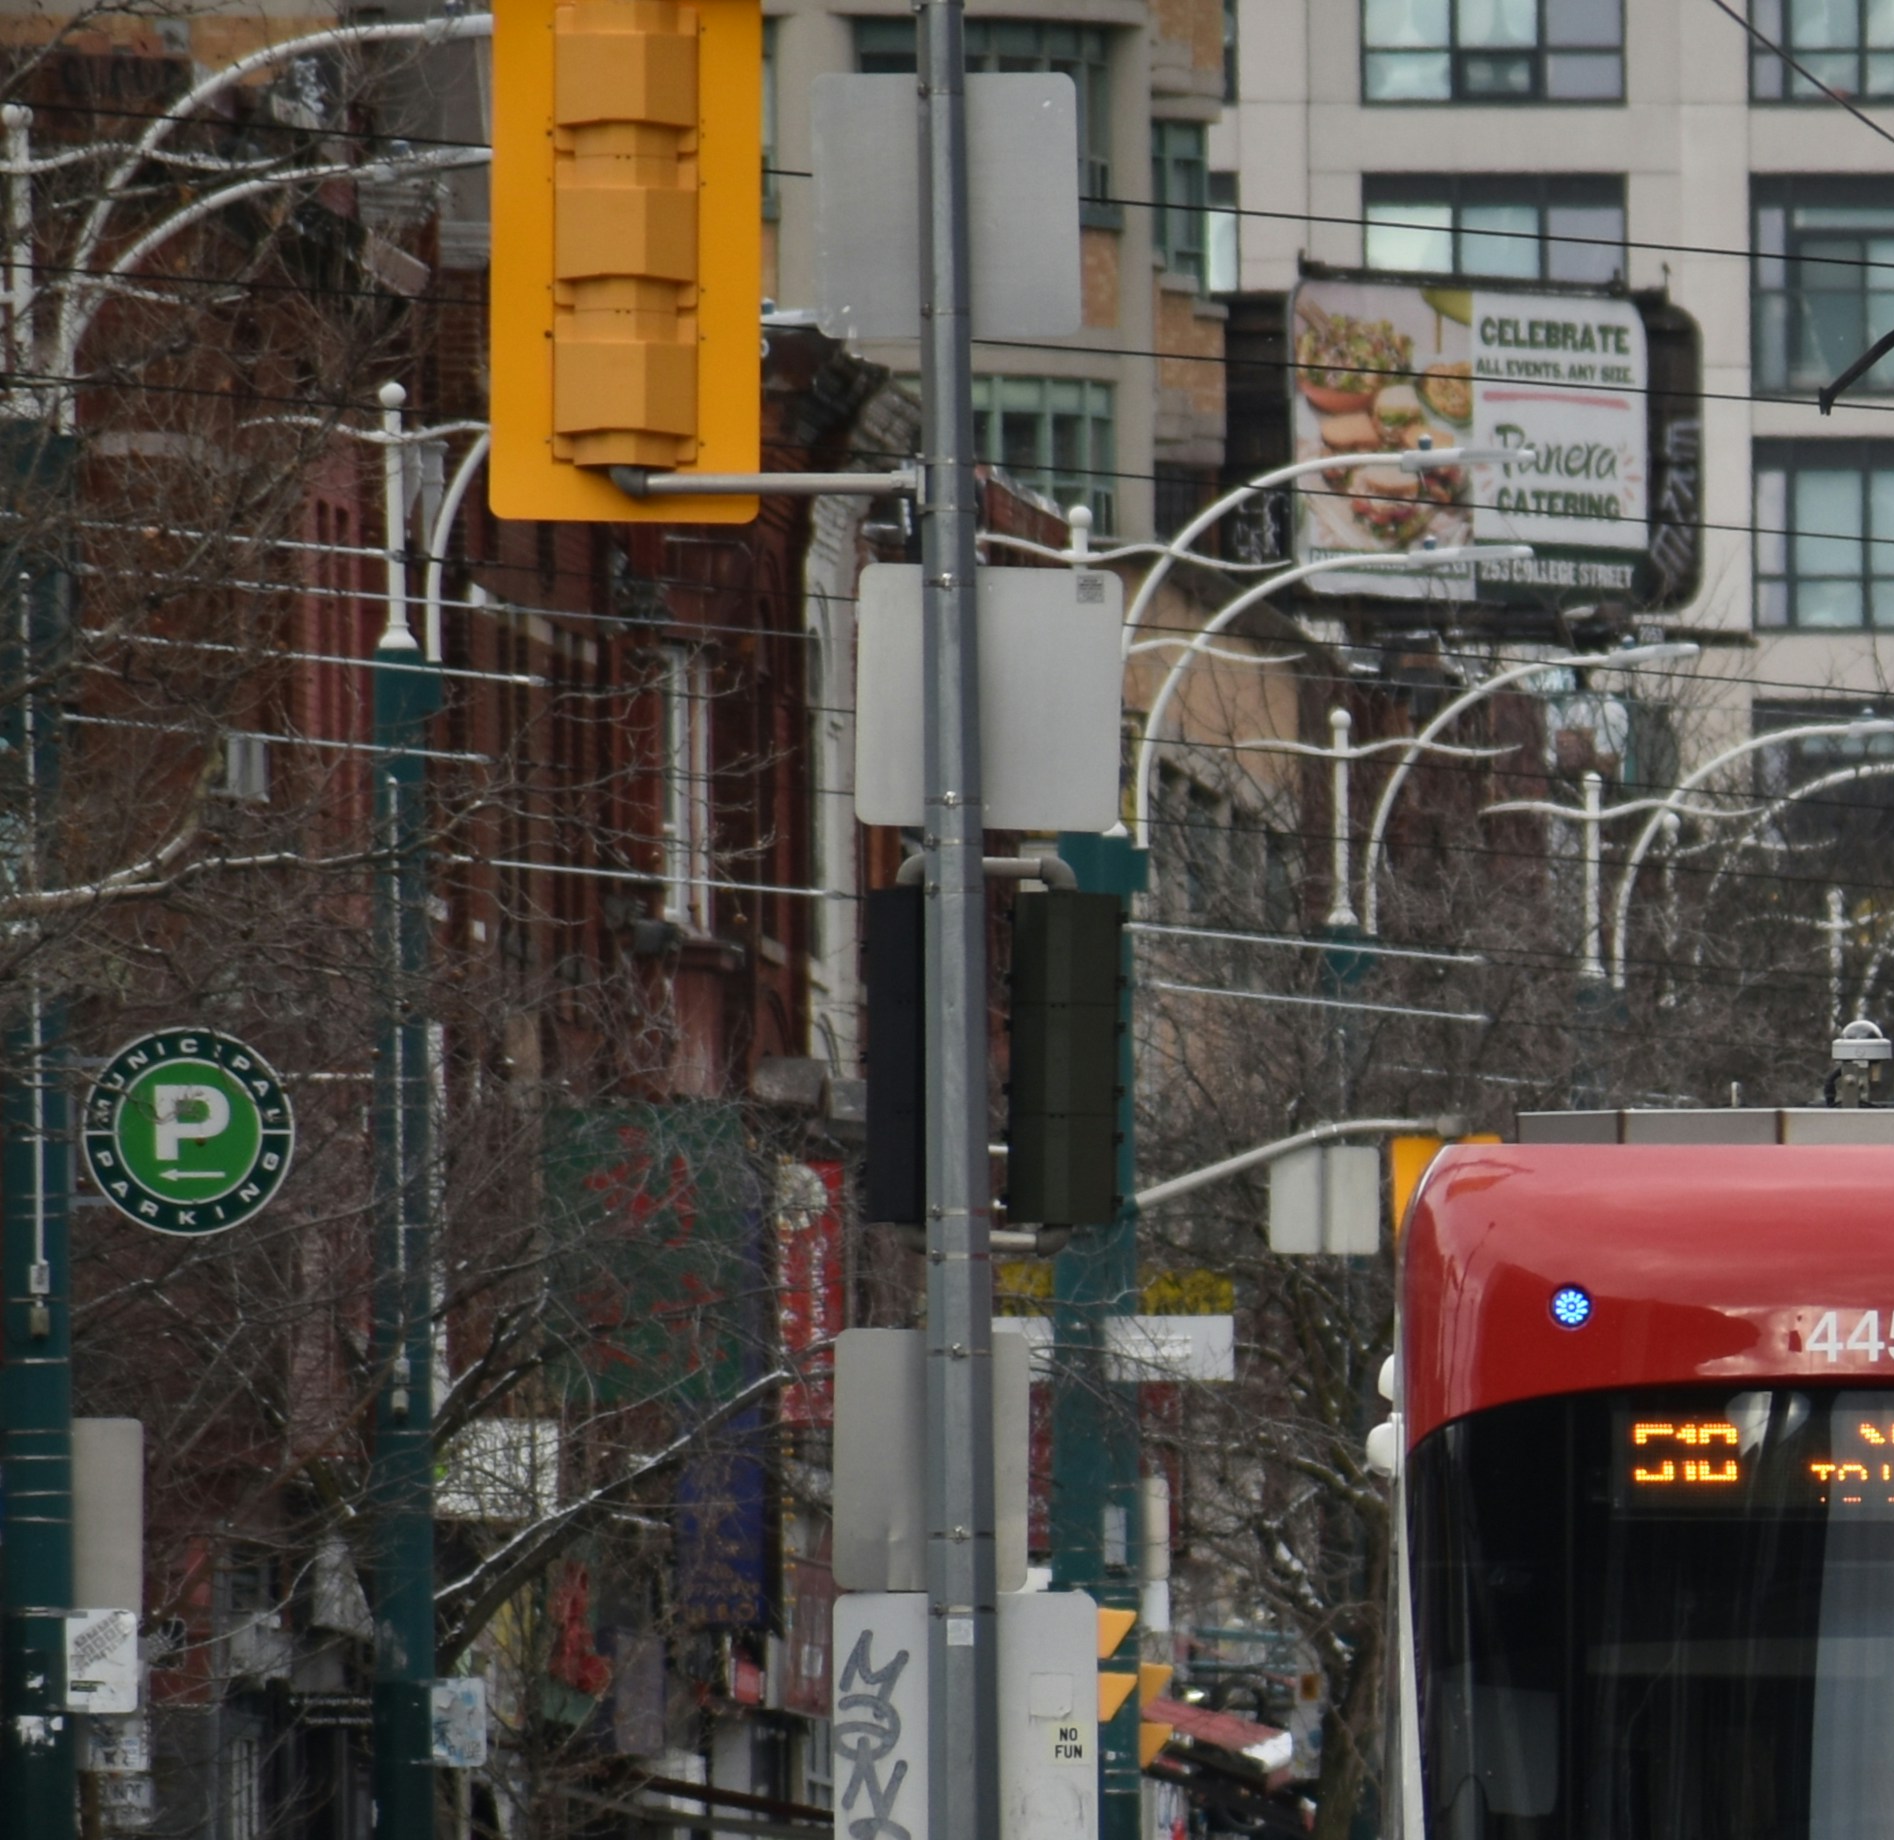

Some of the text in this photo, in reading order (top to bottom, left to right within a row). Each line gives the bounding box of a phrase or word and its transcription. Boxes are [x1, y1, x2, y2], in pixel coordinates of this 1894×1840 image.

[1480, 316, 1630, 355] CELEBRATE
[1476, 357, 1503, 376] ALL
[1568, 364, 1597, 382] ANY
[1495, 423, 1617, 480] Panera
[1497, 486, 1621, 522] CATERING
[1579, 562, 1635, 589] STREET
[97, 1039, 284, 1123] MUNICIPAL
[154, 1084, 231, 1161] P
[97, 1150, 280, 1225] PARKING
[1055, 1744, 1083, 1759] FUN
[1059, 1727, 1078, 1742] NO
